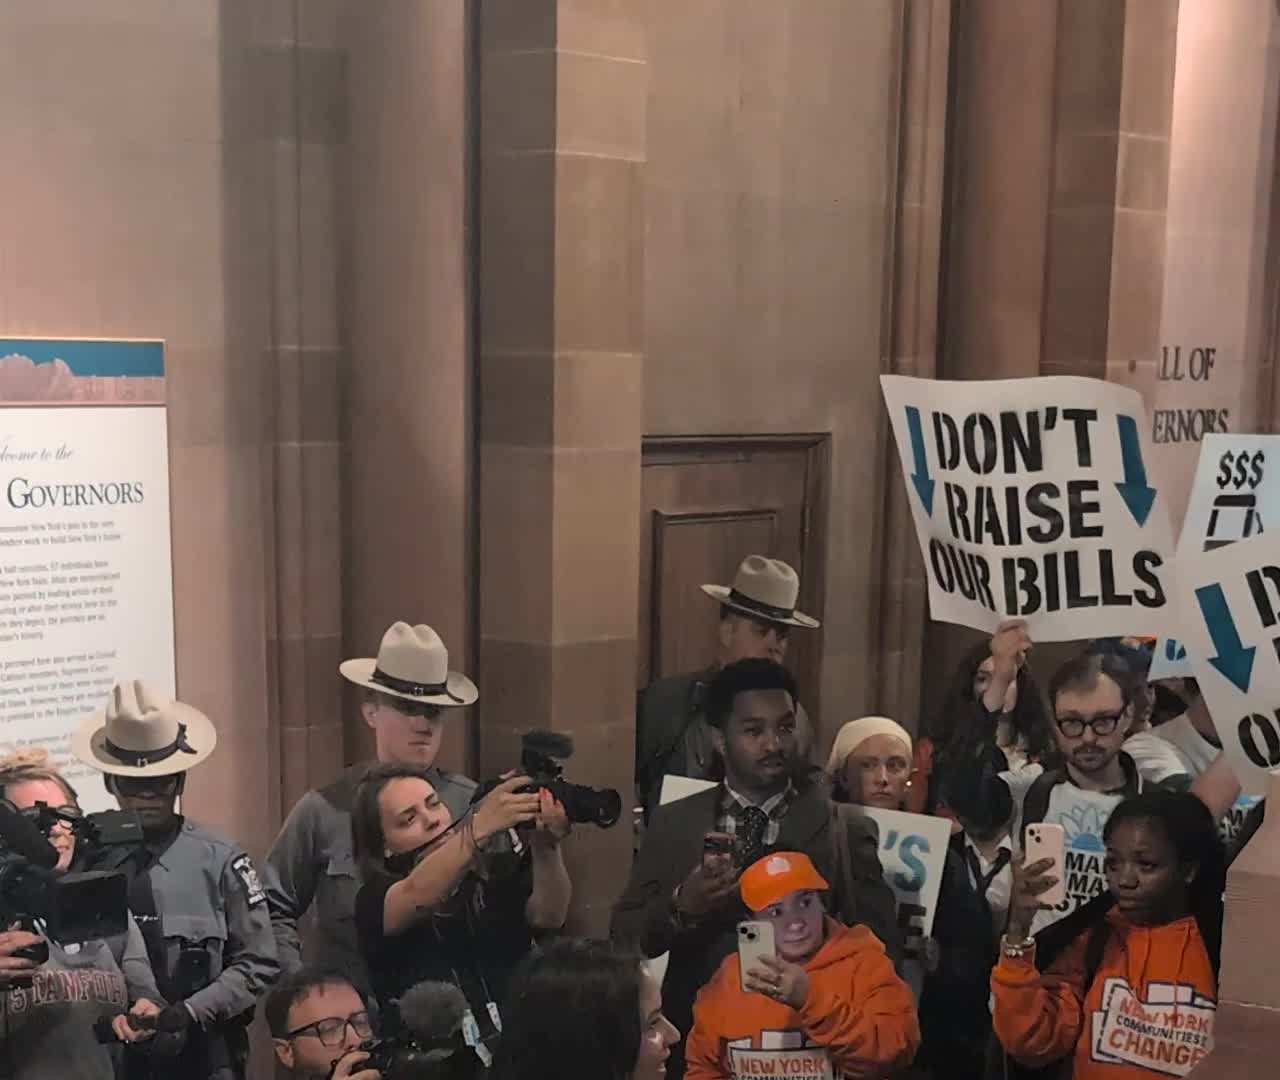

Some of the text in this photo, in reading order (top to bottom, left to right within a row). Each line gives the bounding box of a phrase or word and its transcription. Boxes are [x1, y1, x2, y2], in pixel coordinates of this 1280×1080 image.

[1190, 347, 1216, 381] OF
[55, 441, 75, 461] the
[931, 406, 1099, 474] DON'T
[6, 477, 145, 510] GOVERNORS
[944, 480, 1104, 546] RAISE
[929, 538, 1167, 616] OUR BILLS
[740, 1057, 826, 1075] NEW YORK
